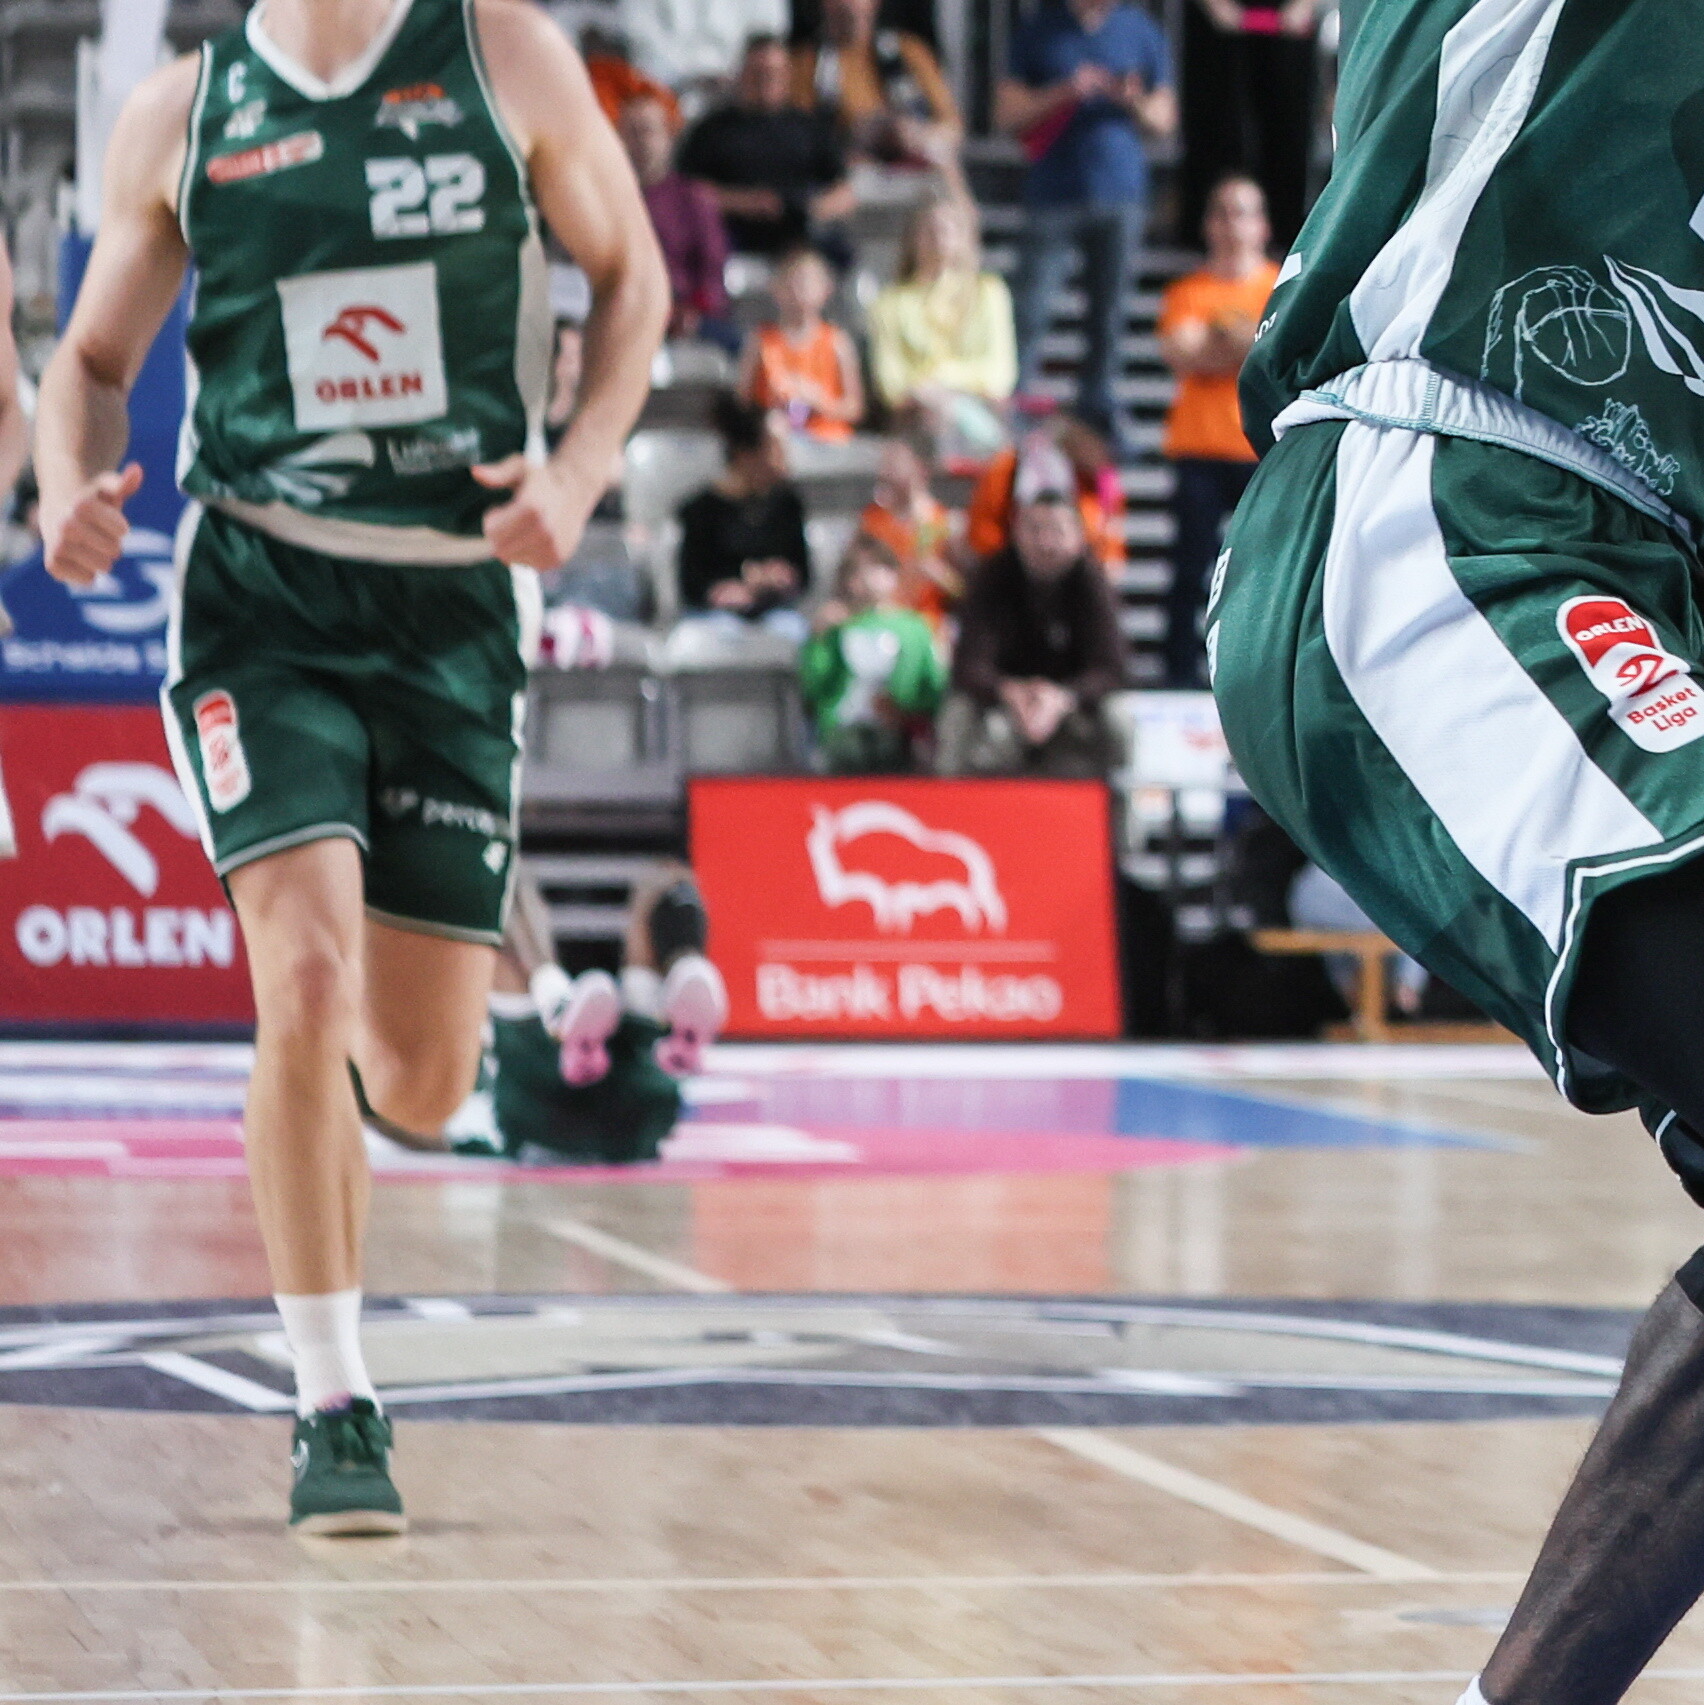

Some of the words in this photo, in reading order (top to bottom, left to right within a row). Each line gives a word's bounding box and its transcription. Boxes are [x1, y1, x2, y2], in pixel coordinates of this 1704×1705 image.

[365, 152, 486, 242] 22
[1575, 615, 1646, 641] ORLEN
[1626, 686, 1698, 725] Basket
[1651, 706, 1699, 732] Liga
[14, 904, 236, 969] ORLEN
[755, 961, 895, 1022] Bank
[897, 961, 1065, 1022] Pekao
